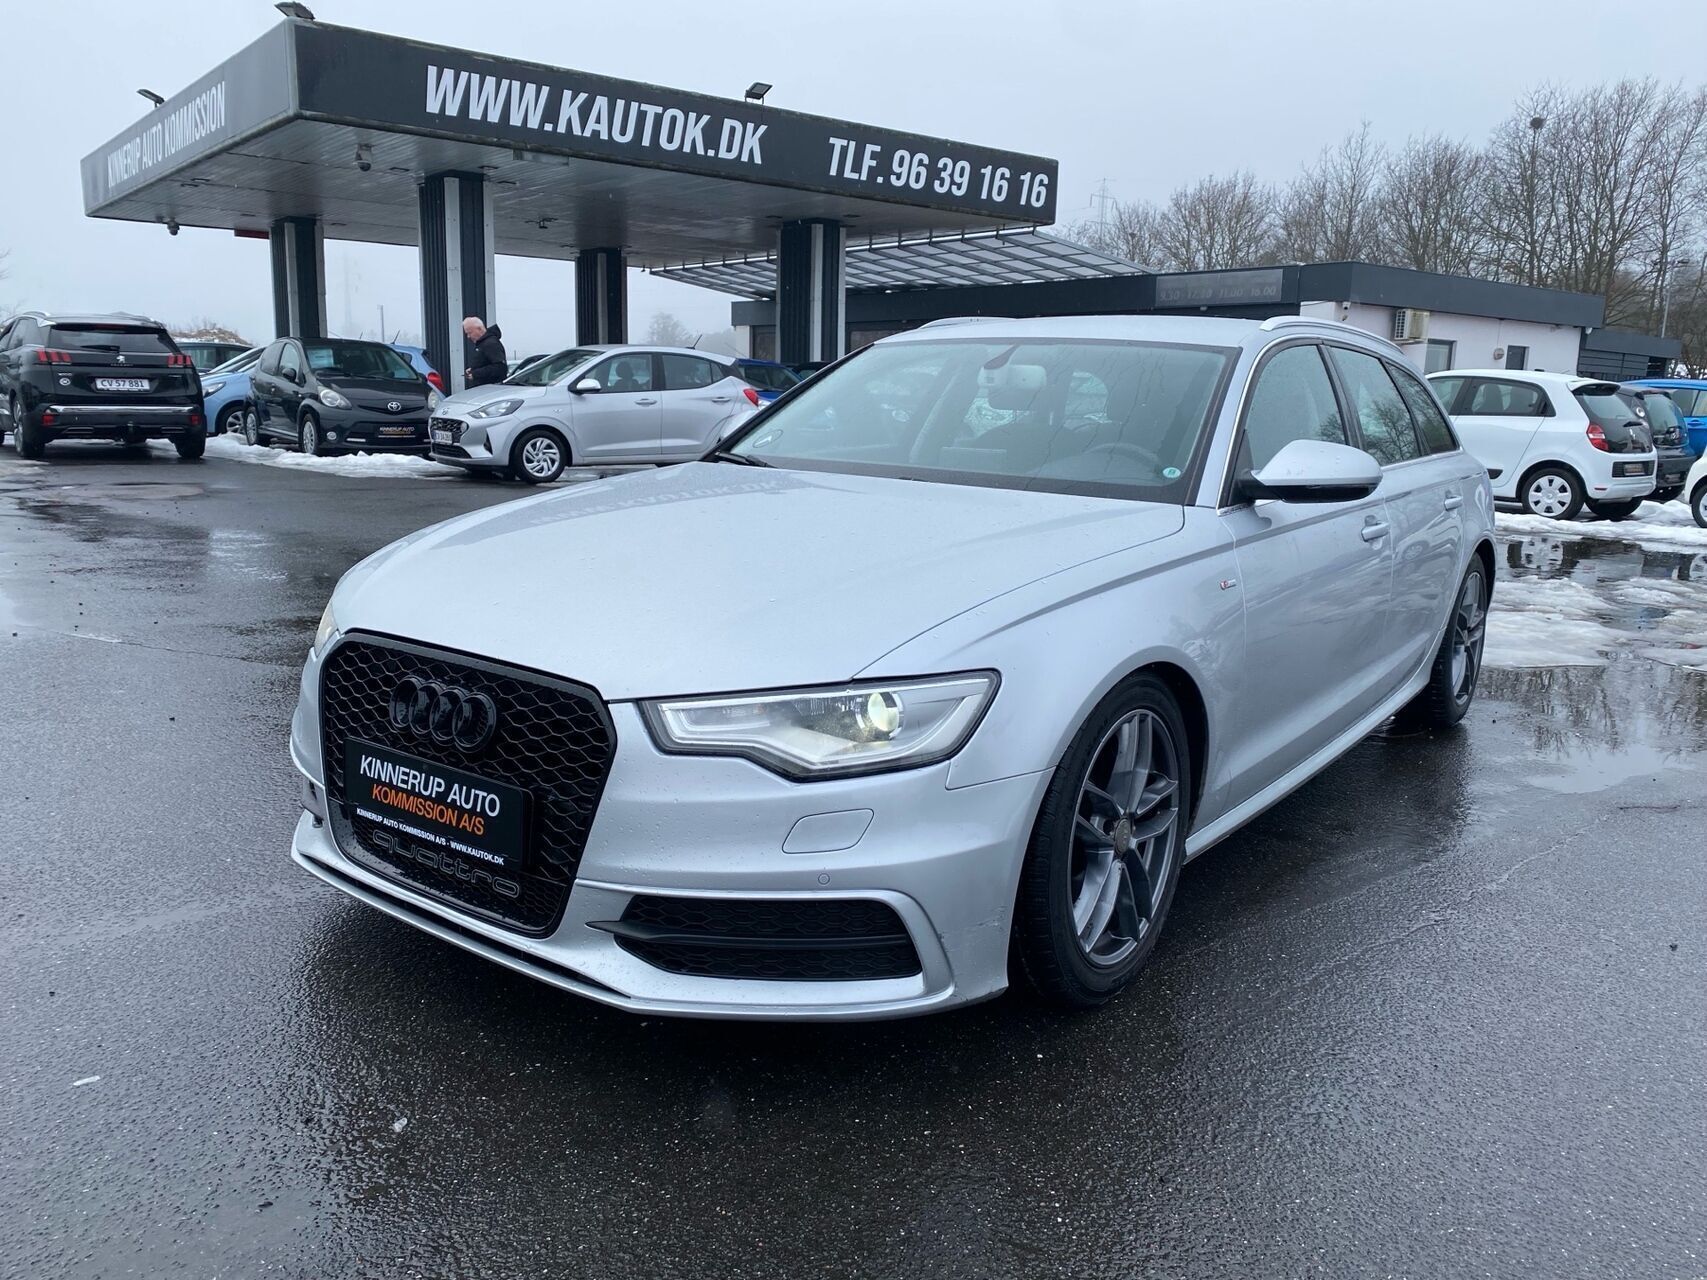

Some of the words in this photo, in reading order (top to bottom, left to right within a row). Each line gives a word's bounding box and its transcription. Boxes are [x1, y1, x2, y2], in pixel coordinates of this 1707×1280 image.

[107, 137, 141, 188] KINNERUP
[142, 122, 163, 170] AUTO
[164, 81, 225, 158] KOMMISSION
[424, 64, 768, 165] WWW.KAUTOK.DK
[828, 137, 883, 184] TLF.
[889, 149, 929, 190] 96
[933, 157, 971, 197] 39
[980, 165, 1010, 203] 16
[1019, 171, 1049, 208] 16
[100, 379, 113, 387] CV
[115, 379, 126, 387] 57
[128, 380, 145, 388] 881
[360, 754, 446, 798] KINNERUP
[447, 783, 500, 817] AUTO
[372, 783, 458, 827] KOMMISSION
[459, 813, 485, 835] A/S
[356, 807, 383, 823] KINNERUP
[383, 817, 399, 829] AUTO
[399, 823, 435, 841] KOMMISSION
[435, 835, 446, 846] A/S
[450, 841, 505, 866] WWW.KAUTOK.DK
[373, 829, 520, 898] quattro
